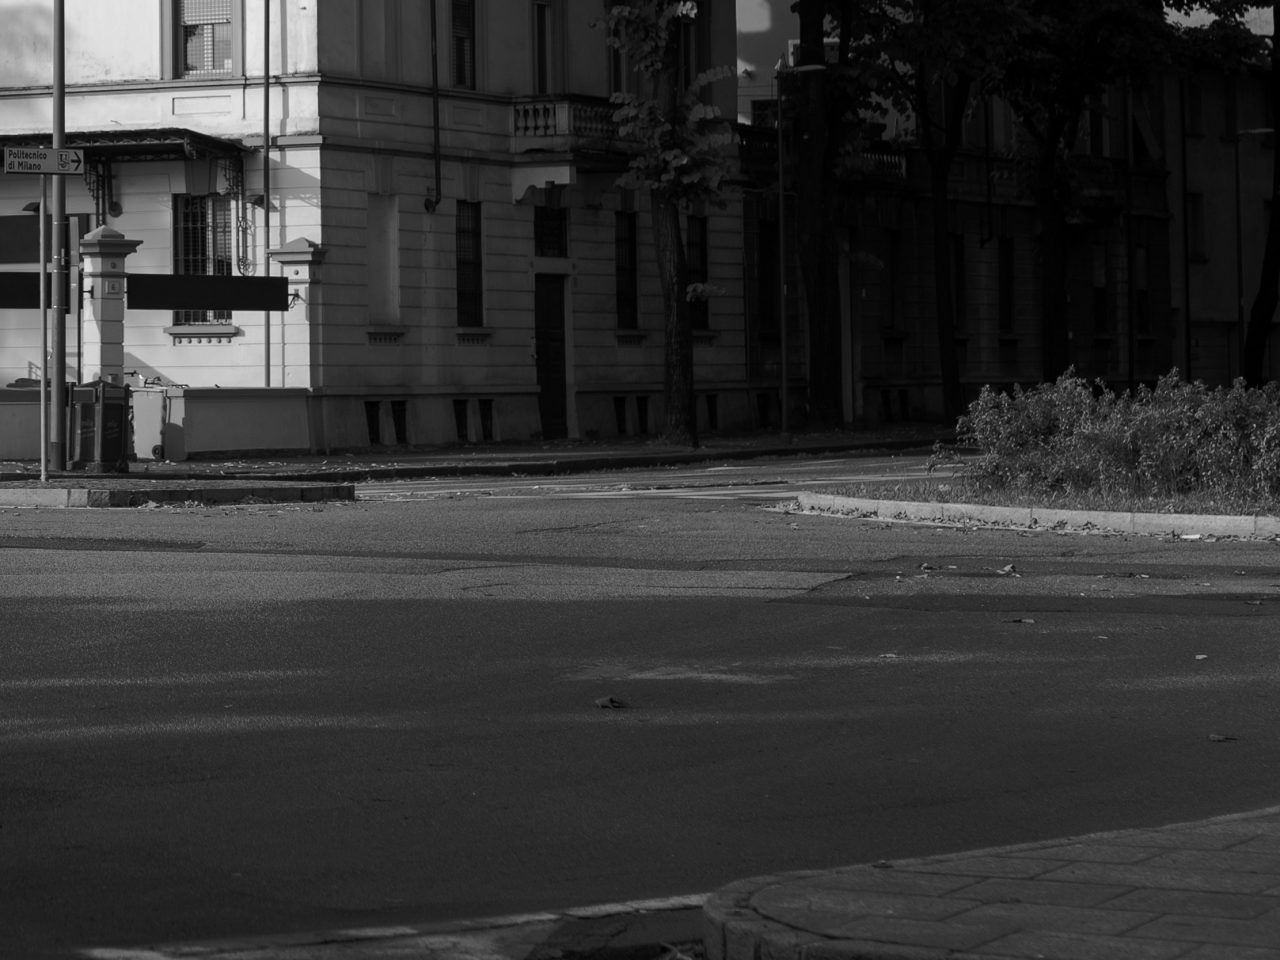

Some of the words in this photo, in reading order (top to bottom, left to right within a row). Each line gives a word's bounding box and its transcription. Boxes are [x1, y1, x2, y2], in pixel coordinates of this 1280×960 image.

[8, 149, 47, 160] Politecnico
[8, 160, 15, 170] di
[18, 161, 41, 171] Milano
